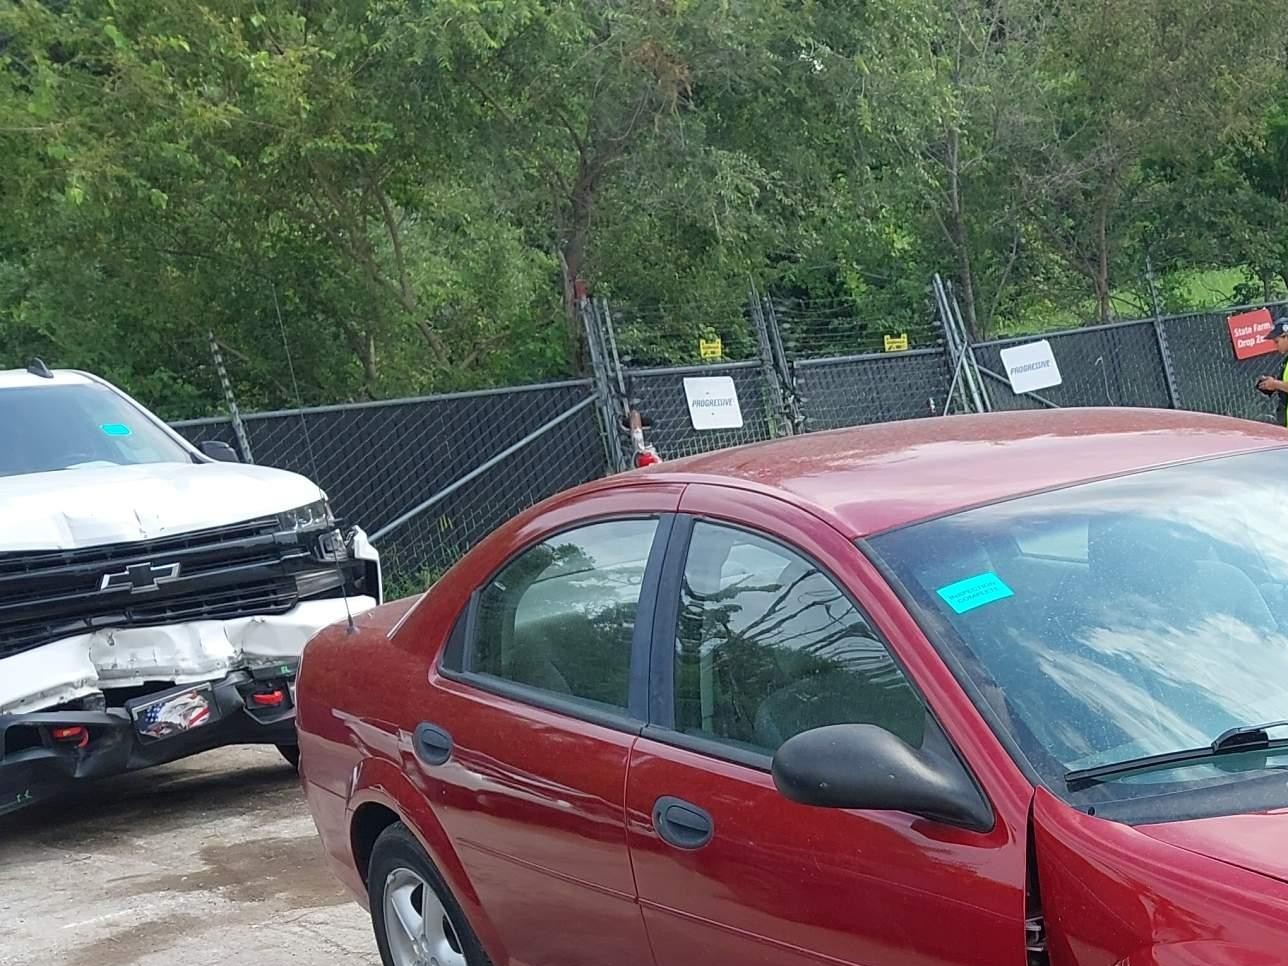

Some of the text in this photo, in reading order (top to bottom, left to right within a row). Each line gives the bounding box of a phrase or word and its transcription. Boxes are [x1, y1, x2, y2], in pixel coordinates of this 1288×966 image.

[1234, 322, 1271, 337] State Farm
[1238, 337, 1256, 348] Drop
[1011, 359, 1050, 376] PROGRESSIVE
[692, 398, 733, 408] PROGRESSIVE
